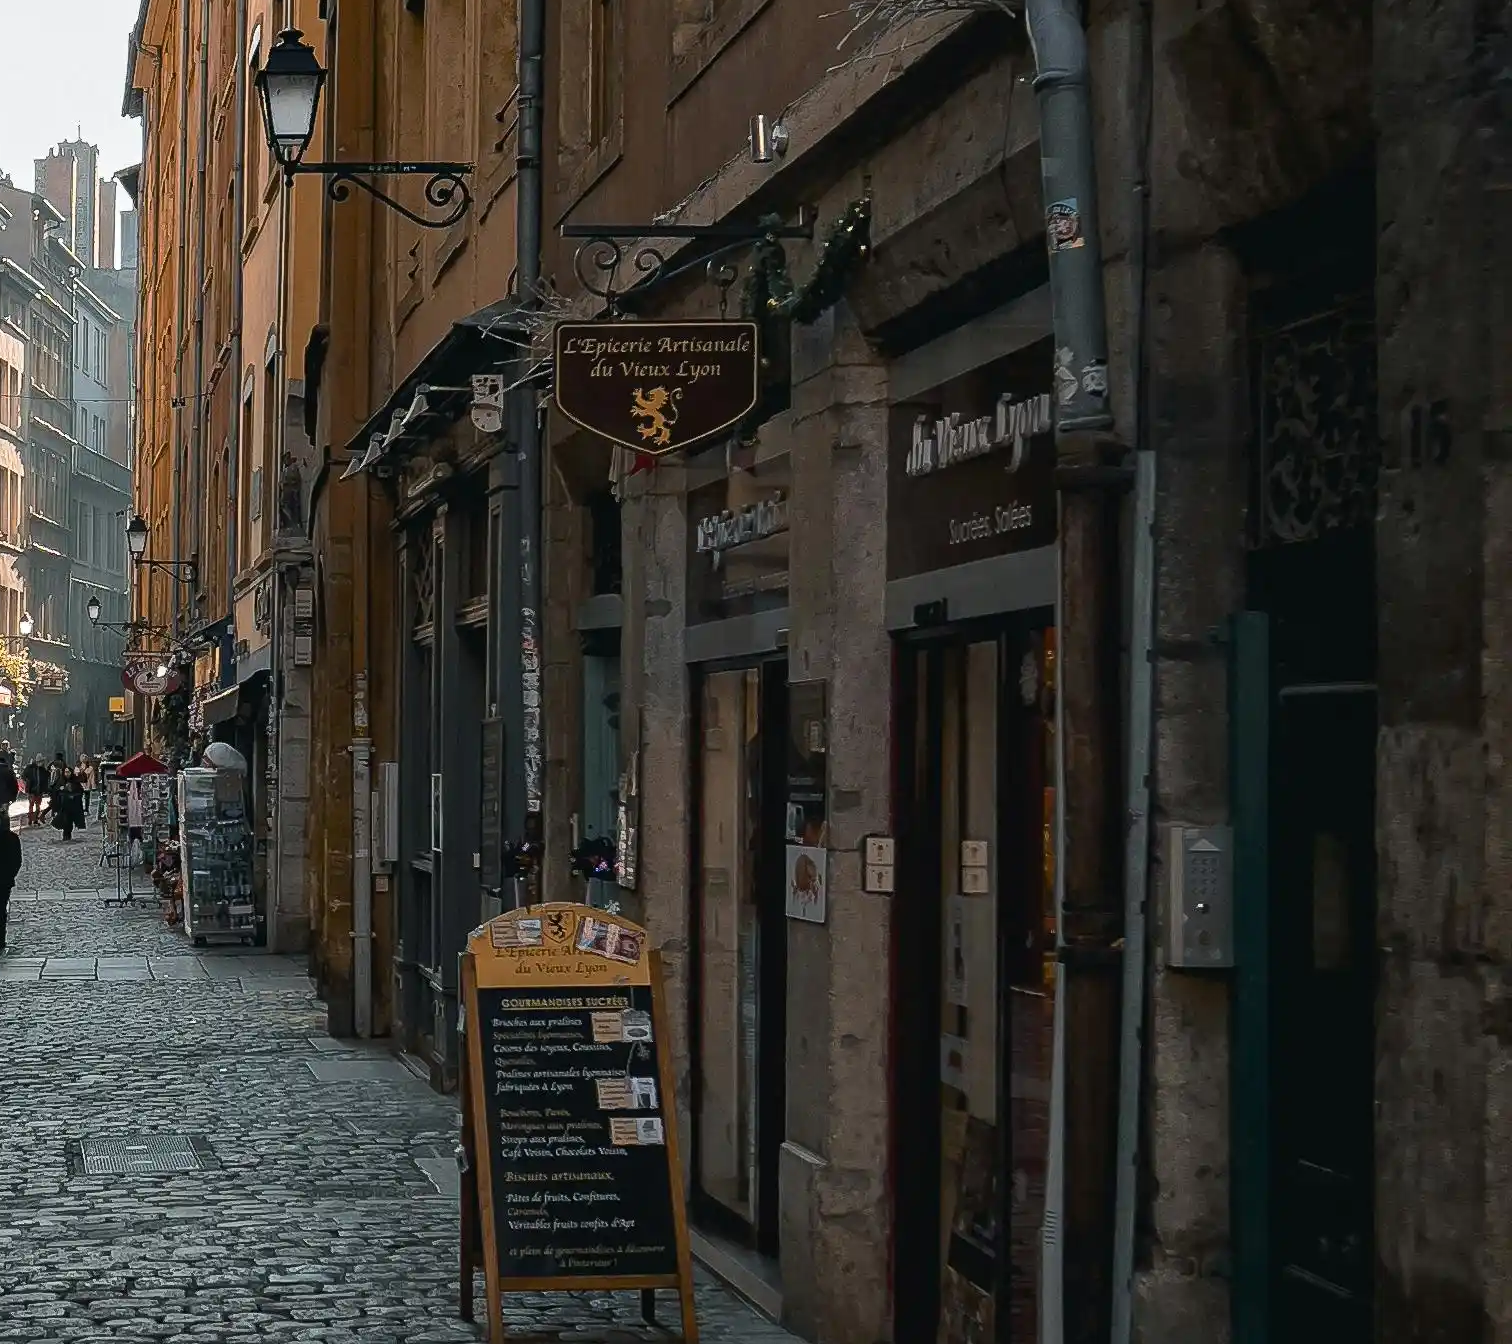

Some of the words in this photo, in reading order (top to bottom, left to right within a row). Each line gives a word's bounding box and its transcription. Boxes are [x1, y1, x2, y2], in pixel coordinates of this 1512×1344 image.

[563, 337, 652, 362] L'Epicerie
[658, 333, 749, 353] Artisanale
[590, 358, 612, 377] du
[620, 361, 669, 377] Vieux
[676, 360, 721, 384] Lyon
[905, 414, 936, 476] du
[935, 412, 992, 469] Vieux
[993, 392, 1053, 474] Lyon
[995, 500, 1032, 534] Salées
[515, 961, 530, 974] du
[536, 962, 571, 974] Vieux
[575, 962, 607, 978] Lyon
[501, 997, 583, 1008] GOURMANDISES
[492, 1016, 527, 1027] Brioches
[530, 1019, 546, 1027] aux
[548, 1016, 583, 1030] pralines
[496, 1068, 532, 1079] Pralines
[533, 1066, 580, 1078] artisanales
[582, 1066, 626, 1080] lyonnaises
[541, 1081, 549, 1091] à
[551, 1081, 574, 1095] Lyon
[529, 1136, 547, 1144] aux
[501, 1146, 522, 1161] Café
[555, 1145, 596, 1157] Chocolats
[504, 1171, 548, 1182] Biscuits
[531, 1191, 542, 1203] de
[553, 1218, 578, 1233] fruits
[580, 1218, 608, 1232] confits
[520, 1245, 541, 1259] plein
[543, 1244, 553, 1255] de
